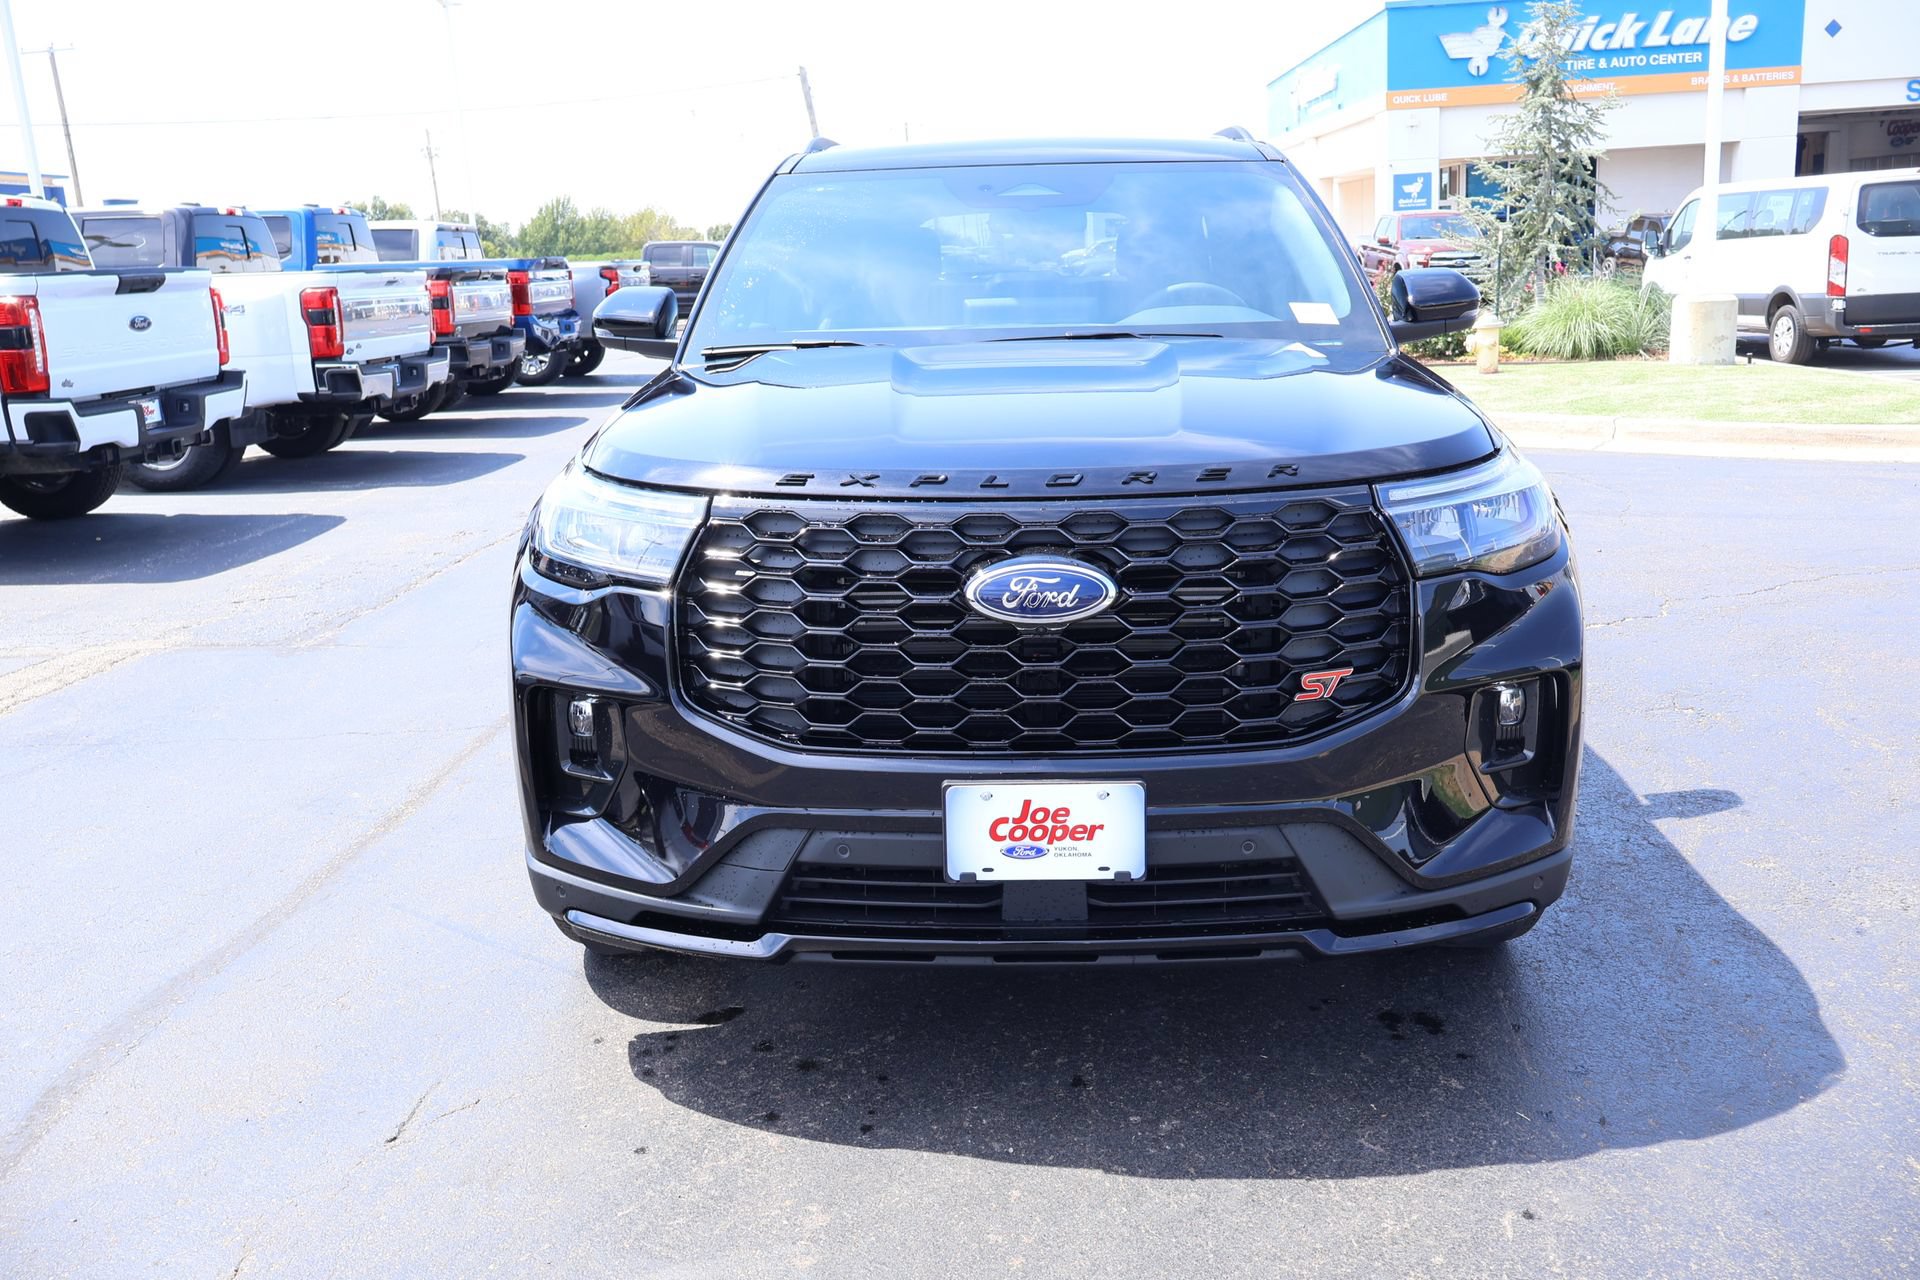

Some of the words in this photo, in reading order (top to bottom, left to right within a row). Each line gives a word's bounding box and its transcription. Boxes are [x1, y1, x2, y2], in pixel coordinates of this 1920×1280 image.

[1566, 59, 1595, 71] TIRE
[1599, 58, 1607, 69] &
[1610, 55, 1646, 68] AUTO
[1650, 52, 1702, 66] CENTER
[1563, 82, 1616, 93] LIGNMENT
[1691, 74, 1730, 86] BRAS
[1733, 73, 1740, 83] &
[1742, 71, 1795, 82] BATTERIES
[1393, 95, 1421, 104] QUICK
[1423, 93, 1447, 102] LUBE
[775, 463, 1300, 488] EXPLORER
[1002, 576, 1081, 608] Ford
[1294, 667, 1354, 701] ST
[1012, 799, 1070, 824] Joe
[989, 817, 1104, 844] Cooper
